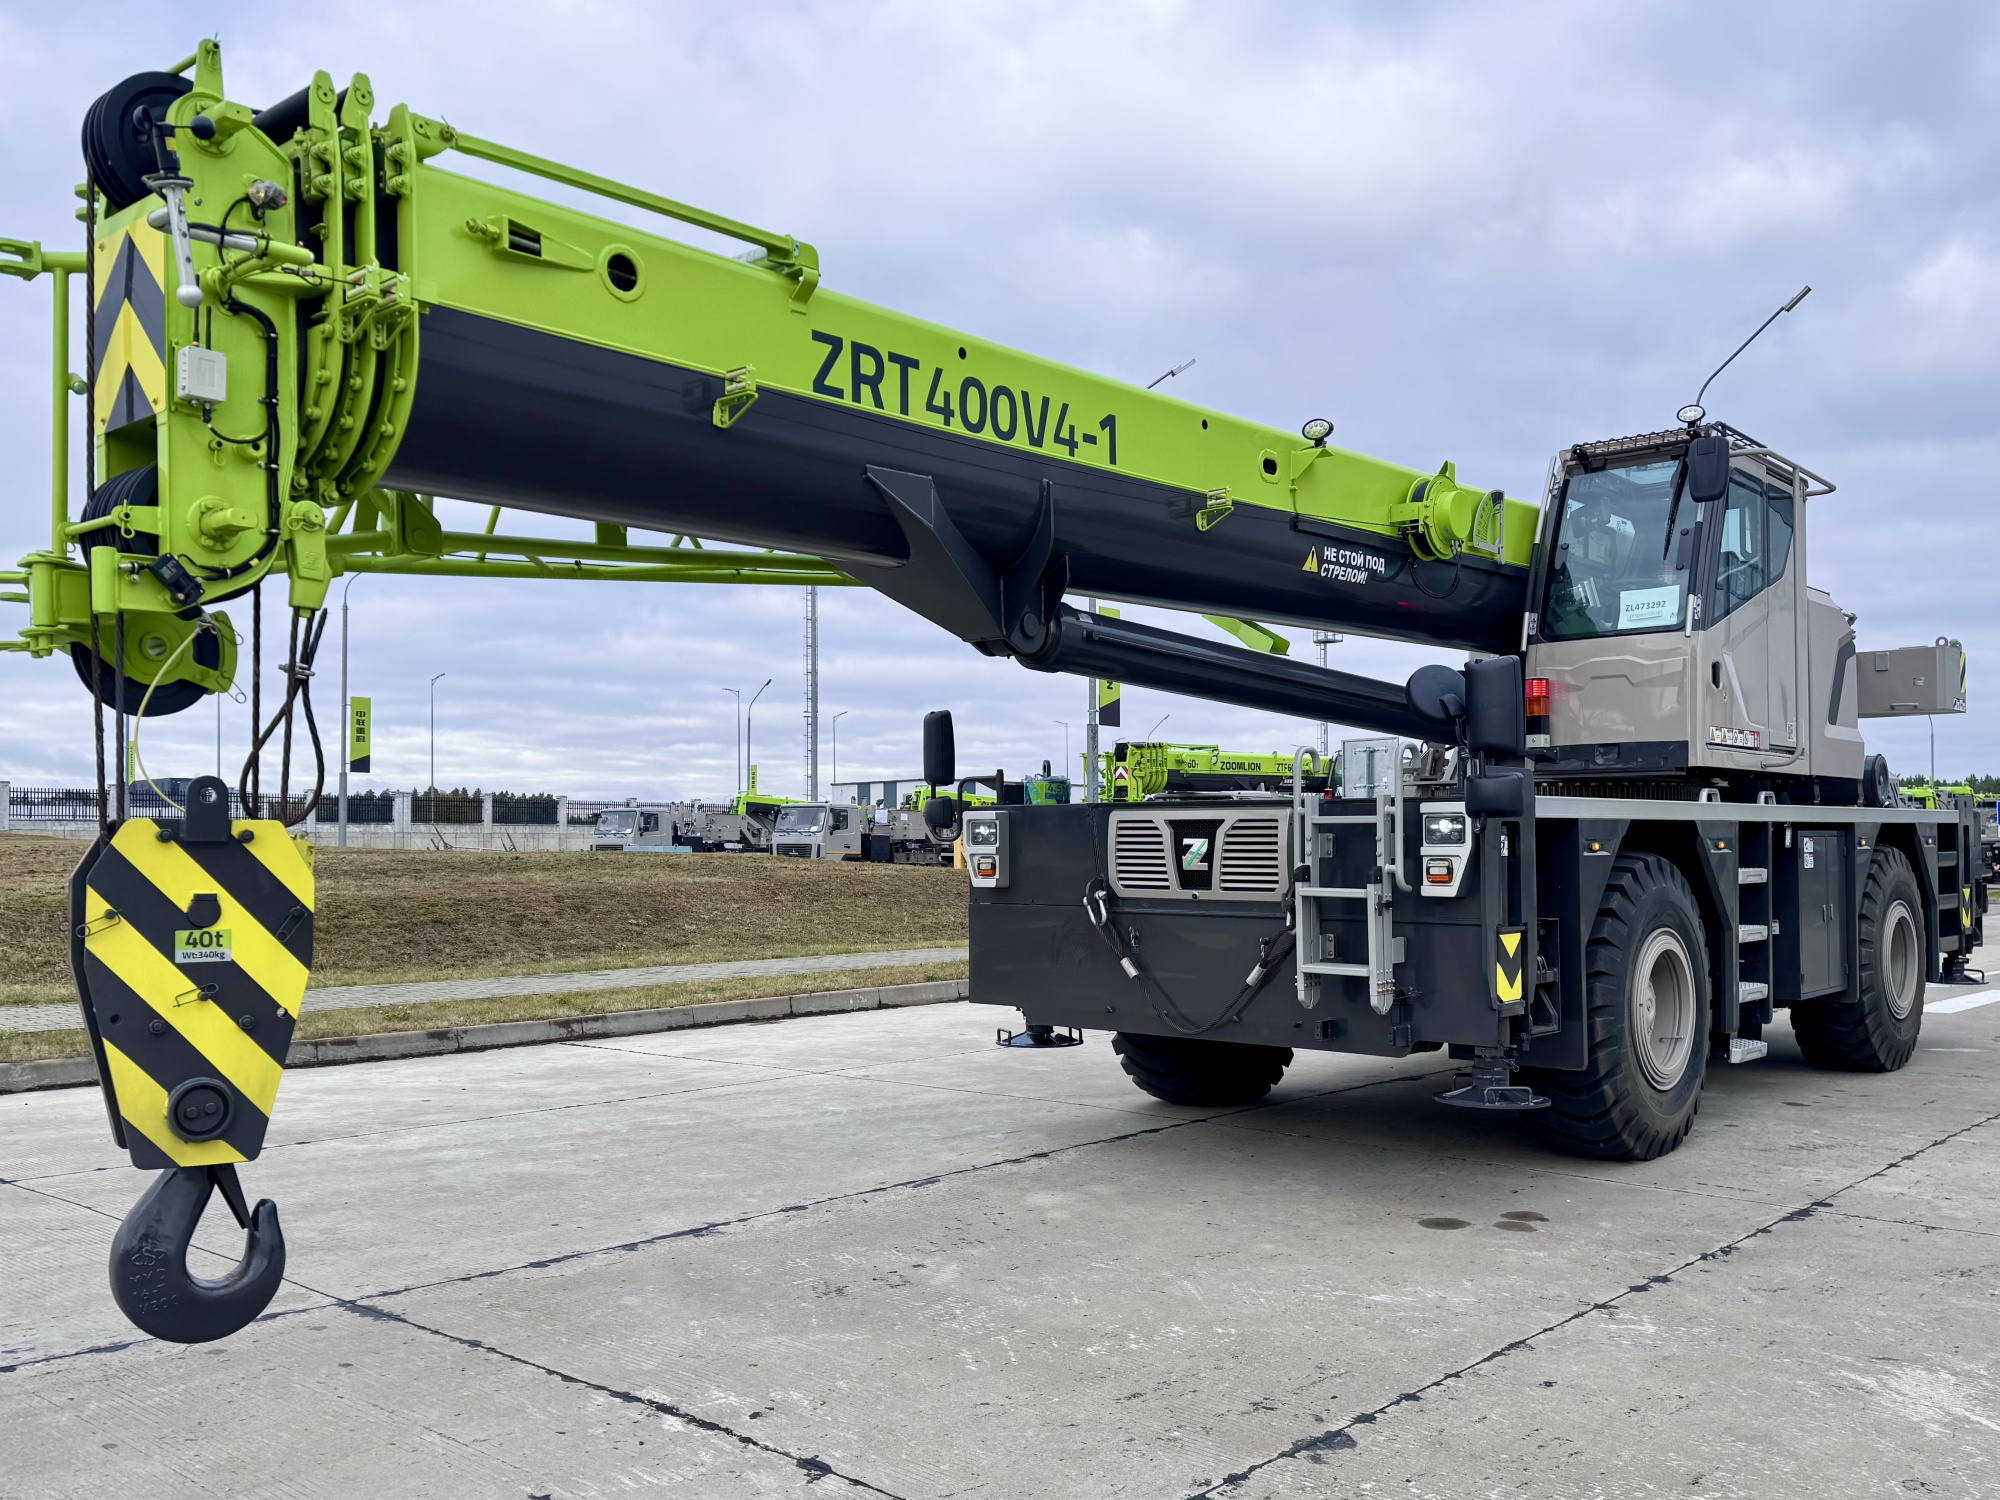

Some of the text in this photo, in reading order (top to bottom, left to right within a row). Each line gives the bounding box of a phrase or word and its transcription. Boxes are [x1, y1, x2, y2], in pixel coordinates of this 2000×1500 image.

[811, 329, 1116, 465] ZRT400V4-1
[1323, 546, 1385, 574] НЕ СТОЙ ПОД
[1320, 563, 1368, 585] СТРЕЛОЙ!
[1625, 600, 1666, 612] ZL473292
[1220, 761, 1261, 771] ZOOMLION
[185, 931, 223, 948] 40t
